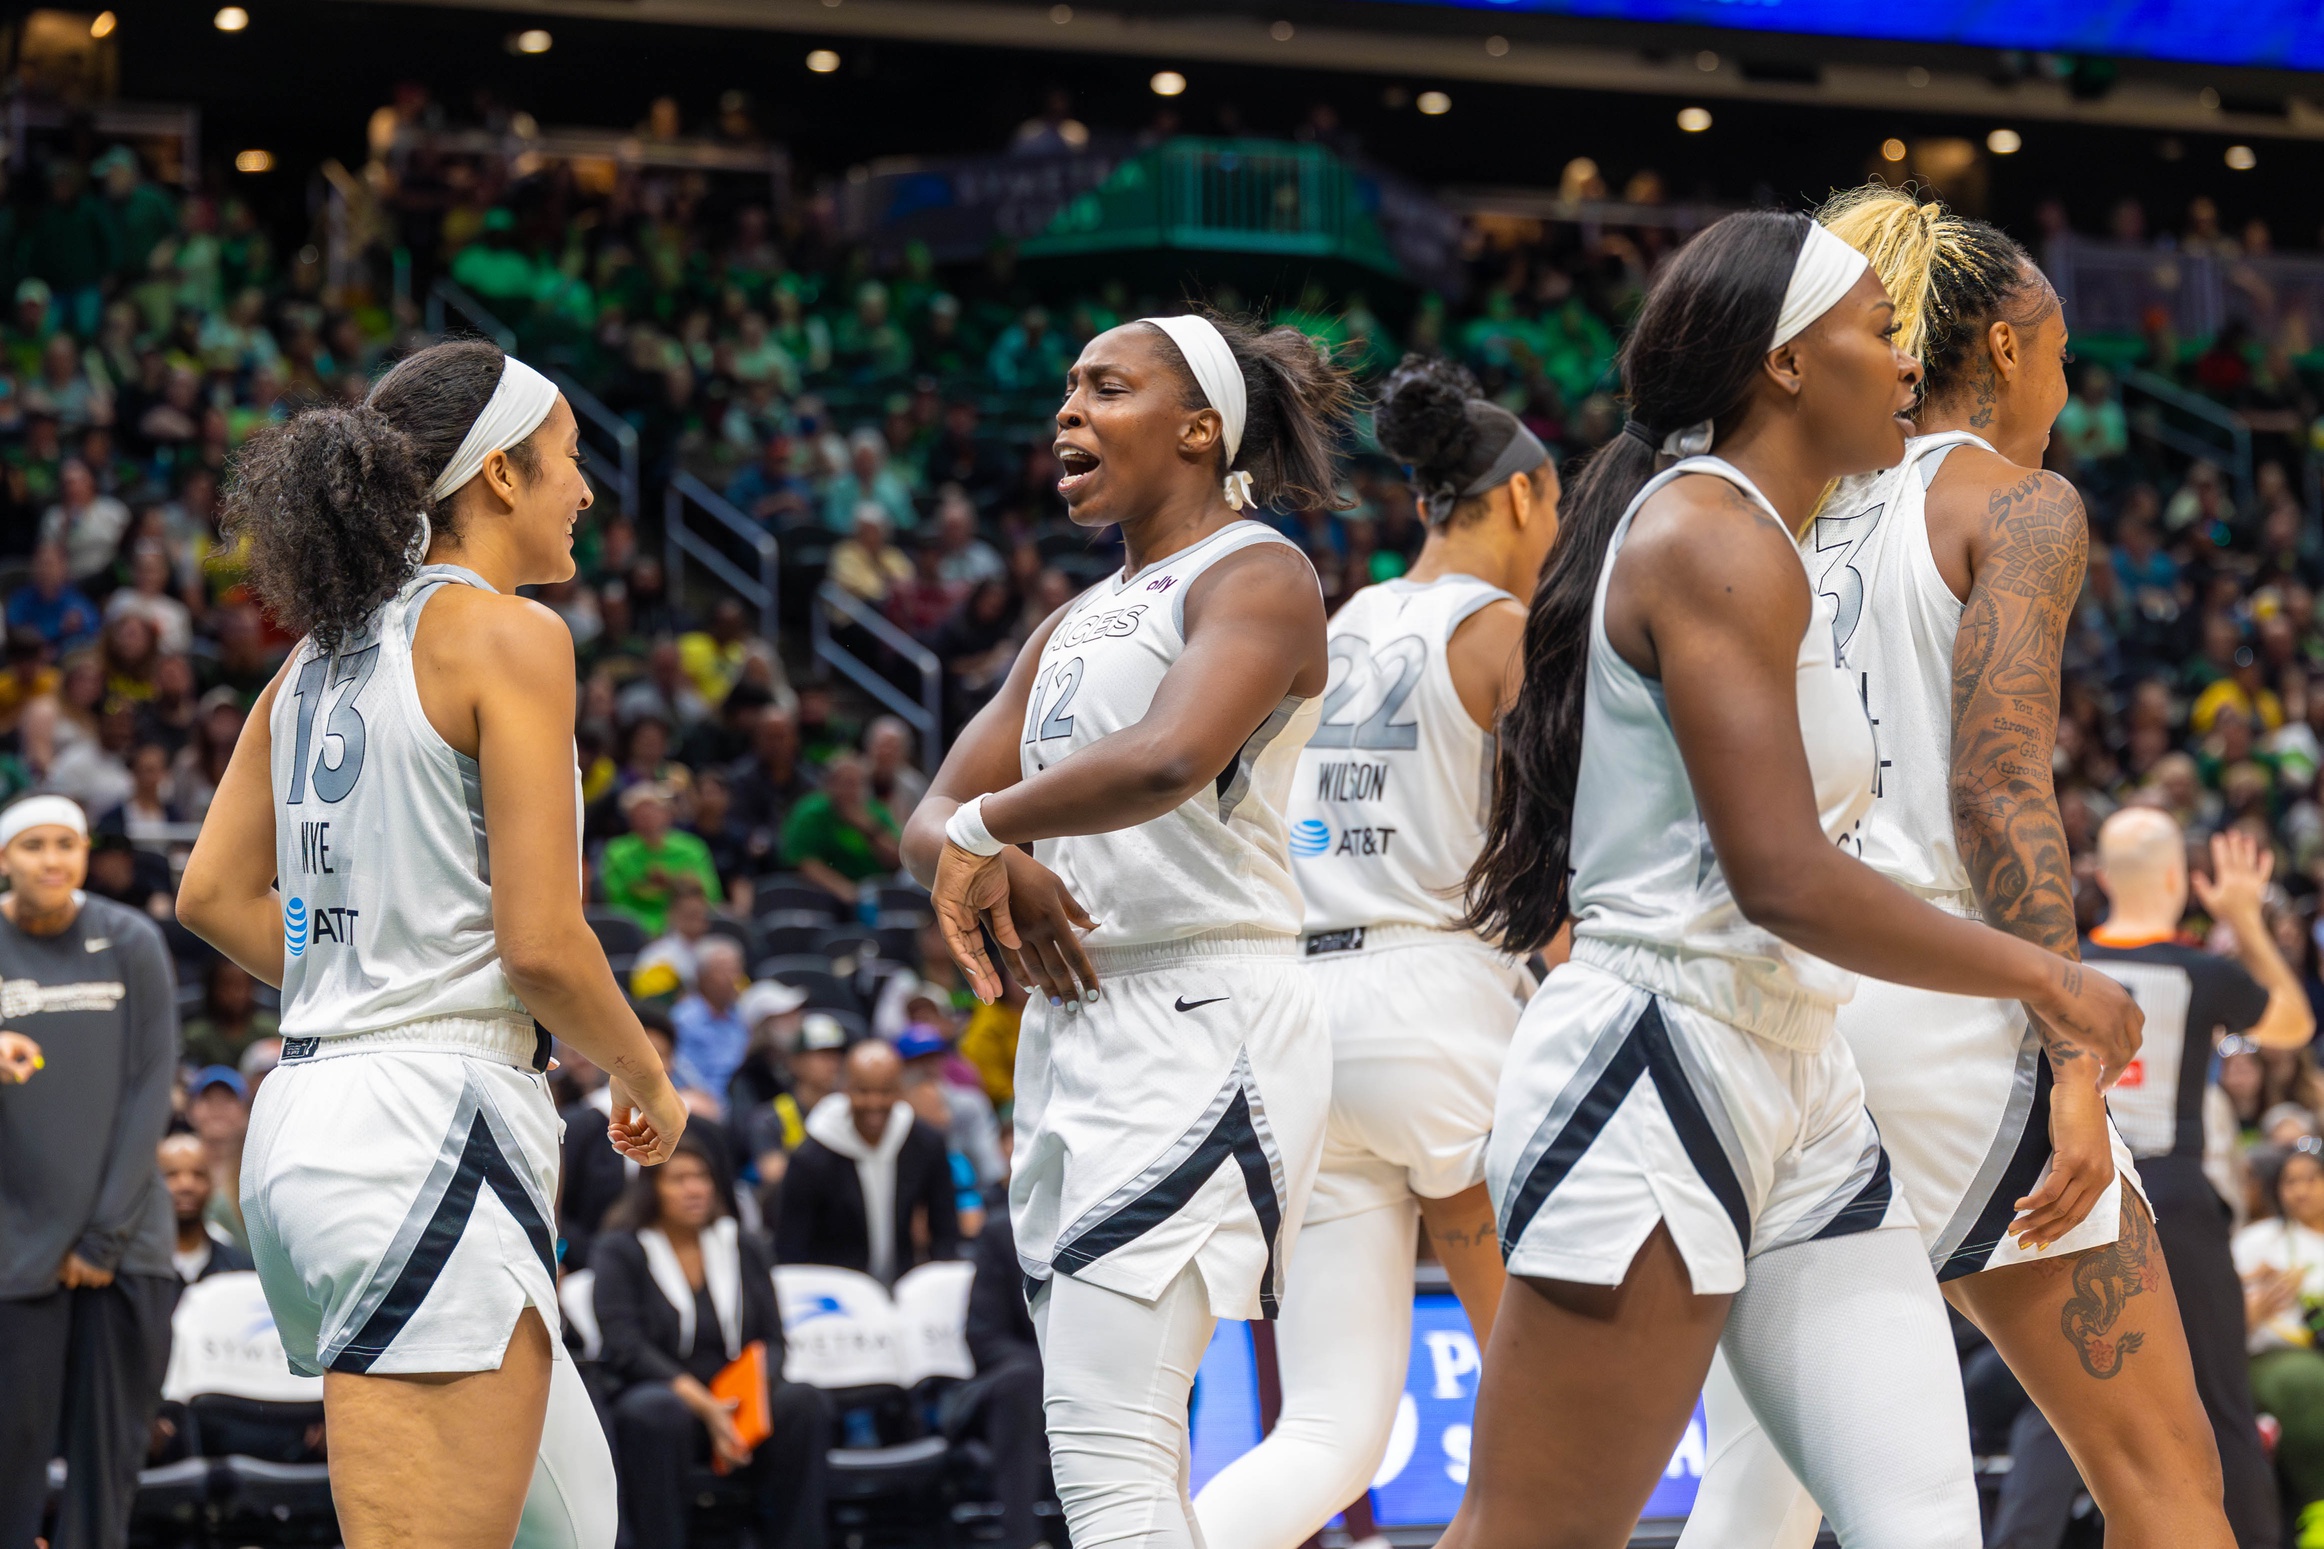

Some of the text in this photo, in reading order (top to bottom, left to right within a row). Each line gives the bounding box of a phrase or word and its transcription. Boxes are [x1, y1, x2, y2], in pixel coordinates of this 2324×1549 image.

[1988, 469, 2044, 532] Sur
[1146, 574, 1178, 593] ally
[1050, 604, 1149, 652] ACES
[1025, 656, 1085, 745] 12
[1304, 632, 1428, 751] 22
[286, 643, 380, 804] 13
[301, 821, 335, 875] NYE
[1335, 826, 1397, 857] AT&T
